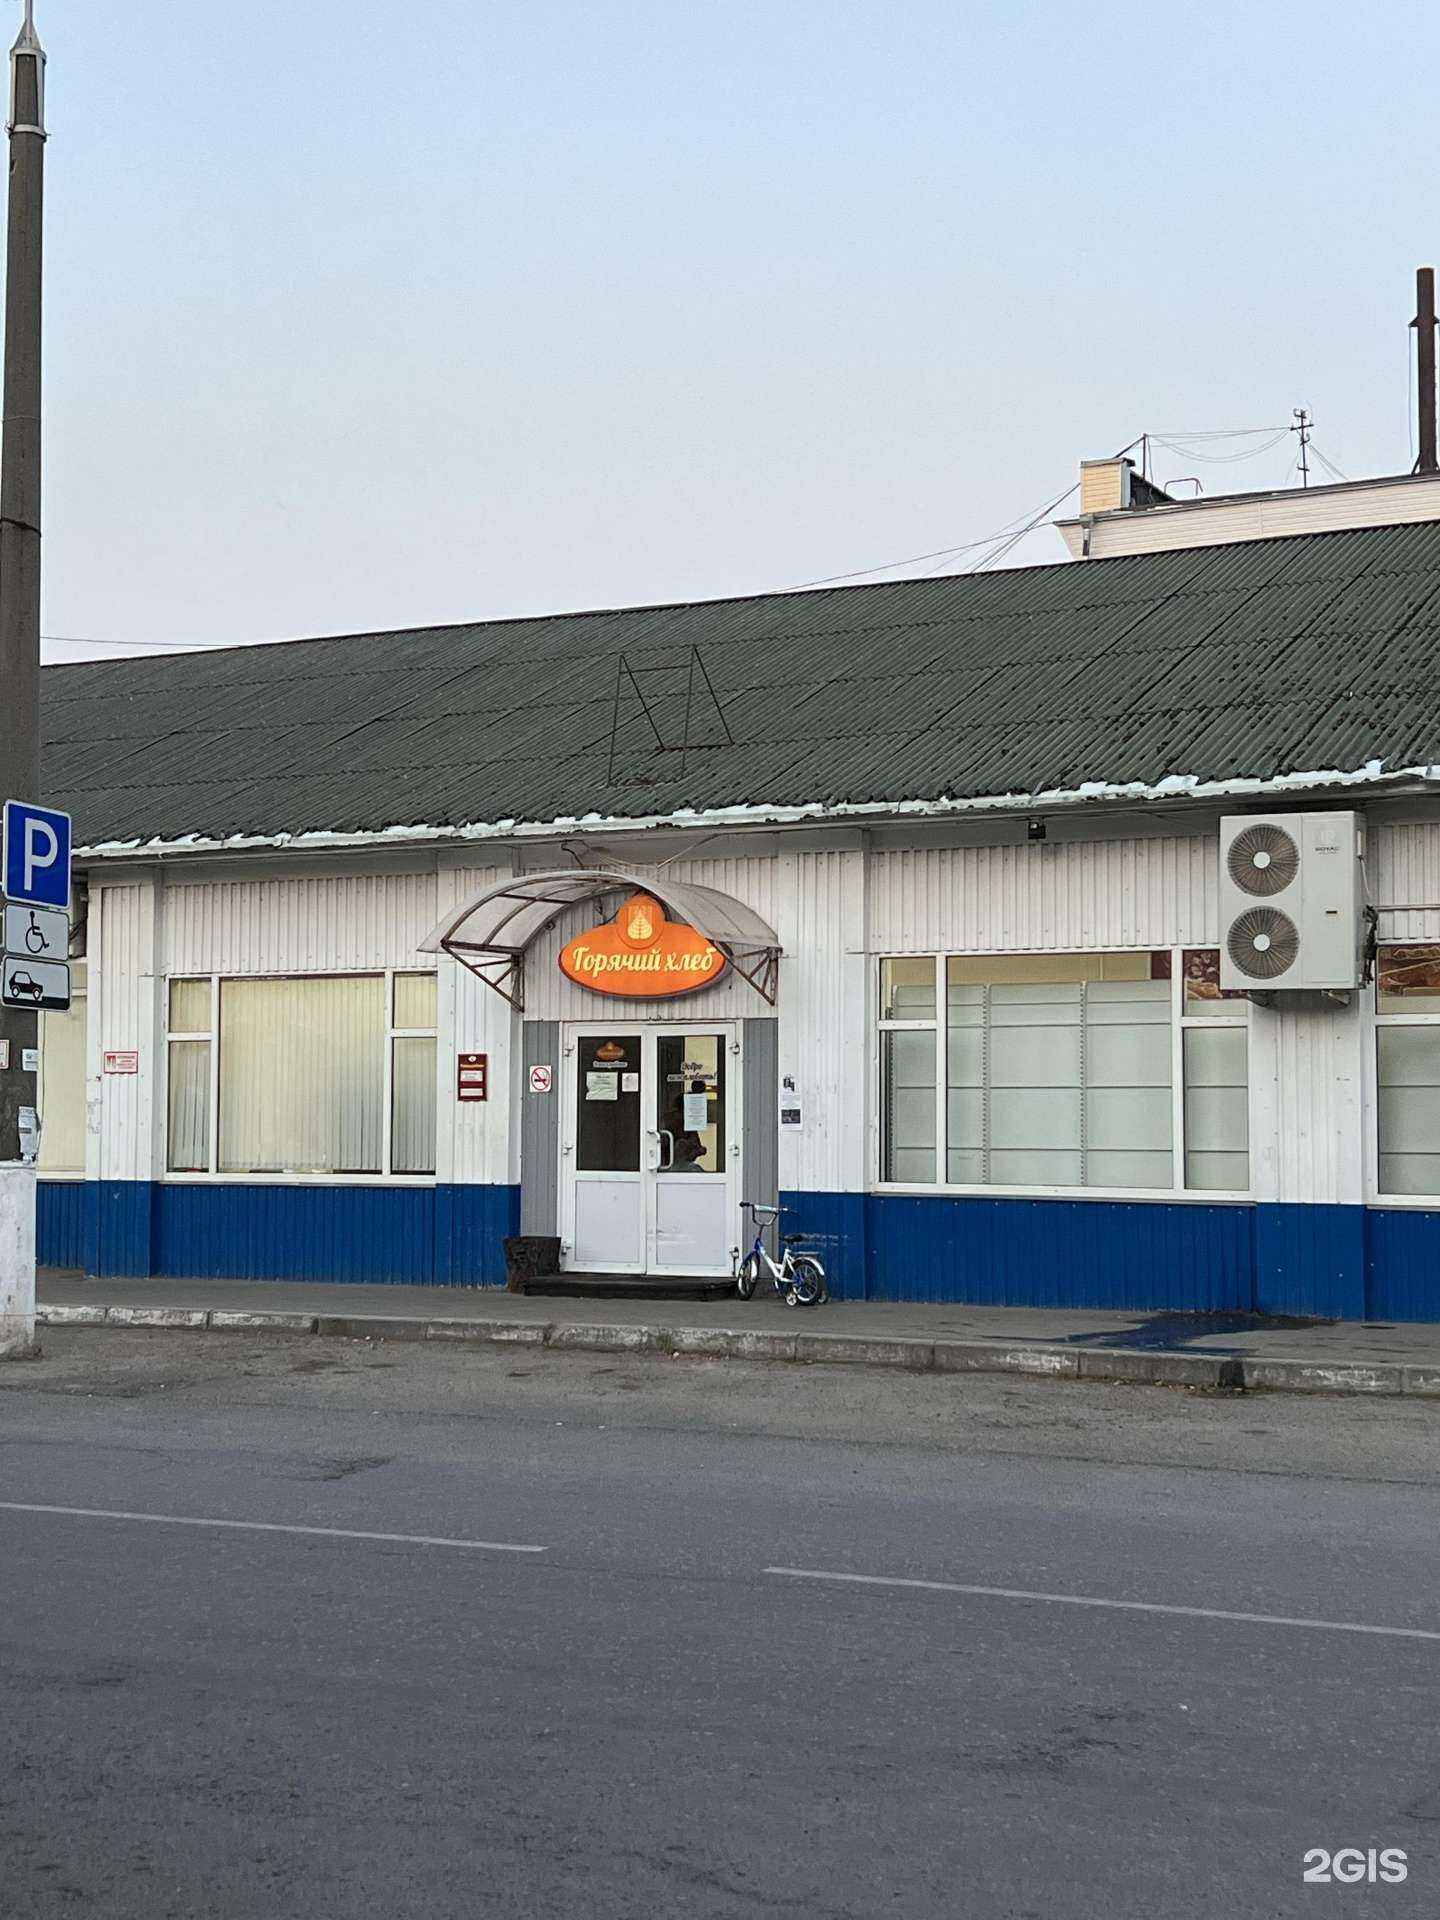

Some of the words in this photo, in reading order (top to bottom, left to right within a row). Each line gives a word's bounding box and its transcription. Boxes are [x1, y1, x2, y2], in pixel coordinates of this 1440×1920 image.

[24, 817, 58, 891] P
[572, 946, 661, 978] Горячий
[664, 946, 718, 972] хлеб
